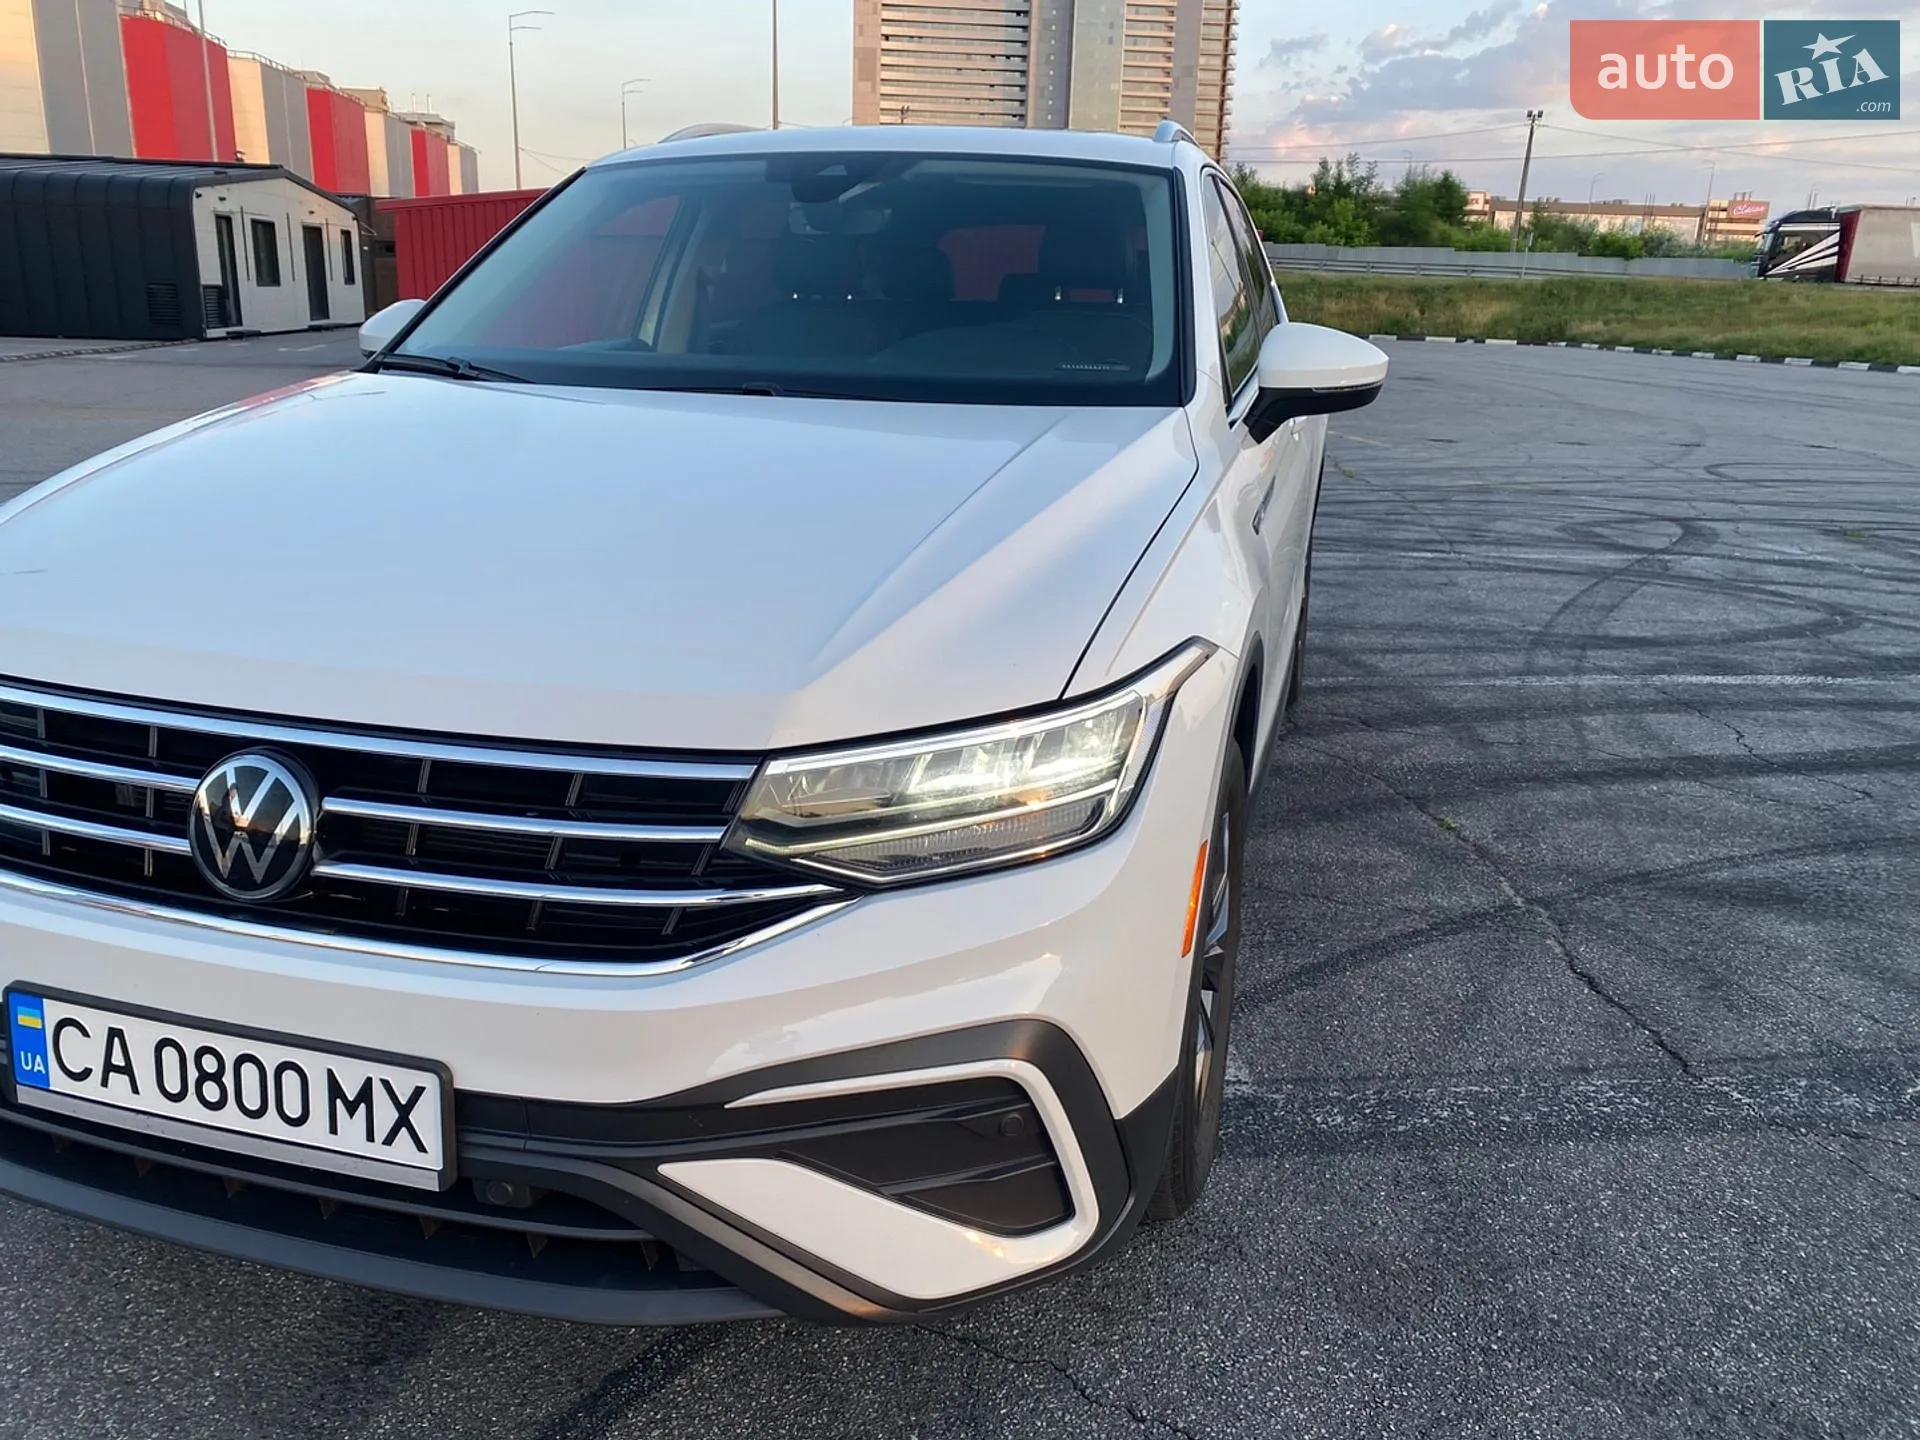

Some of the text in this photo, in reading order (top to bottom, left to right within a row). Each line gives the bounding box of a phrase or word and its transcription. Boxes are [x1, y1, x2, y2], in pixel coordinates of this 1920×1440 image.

[20, 1050, 46, 1075] UA
[51, 1016, 429, 1154] CA 0800 MX
